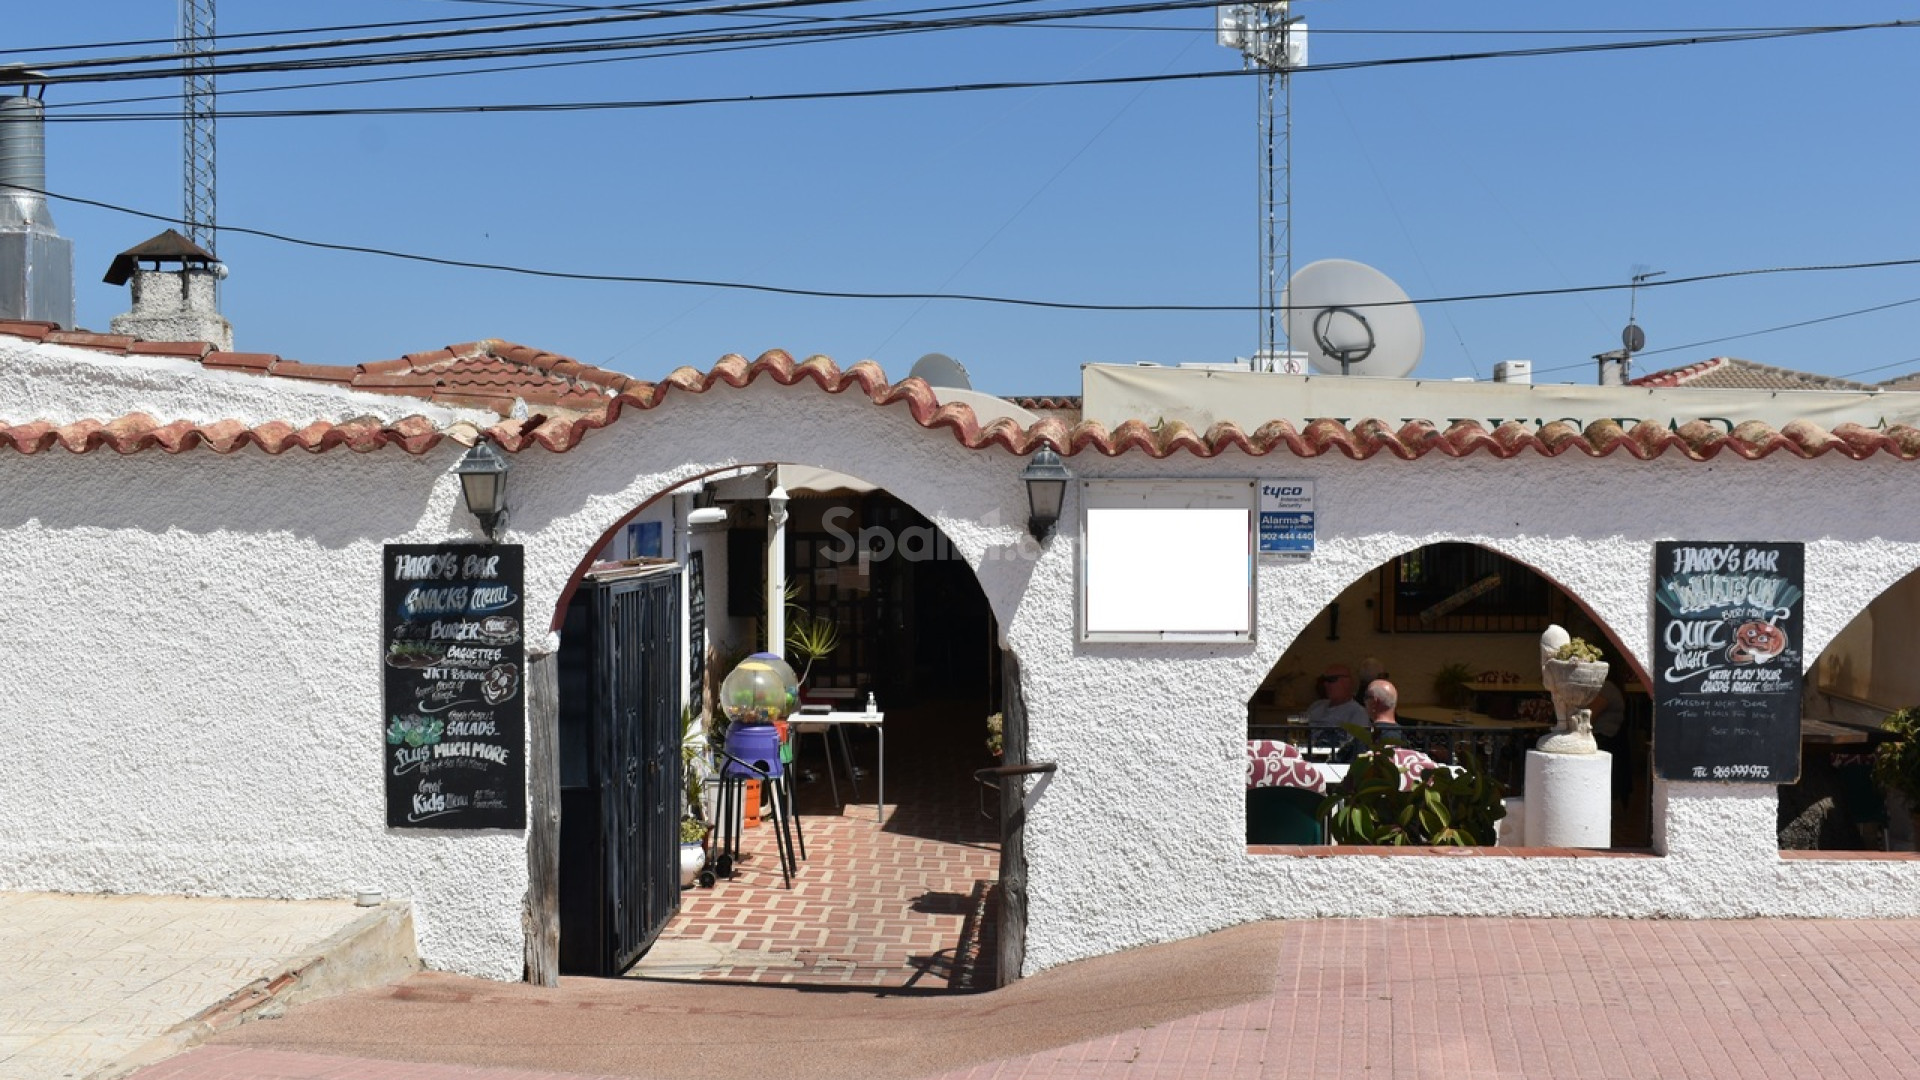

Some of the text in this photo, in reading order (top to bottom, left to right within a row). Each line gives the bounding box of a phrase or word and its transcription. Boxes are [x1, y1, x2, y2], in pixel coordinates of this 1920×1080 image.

[1262, 485, 1303, 498] tyco
[1262, 515, 1300, 524] Alarma
[1261, 532, 1313, 540] 902 444 440
[462, 554, 500, 579] BAR
[1672, 544, 1779, 574] HARRY'S BAR
[405, 586, 469, 615] SNACKS
[1748, 576, 1777, 610] ON
[431, 619, 480, 640] BURGER
[1664, 620, 1726, 652] QUIZ
[1674, 650, 1714, 671] NIGHT
[422, 668, 449, 680] JKT
[1708, 668, 1783, 681] WITH PLAY YOUR
[1701, 680, 1731, 693] CARDS
[1731, 682, 1761, 693] RIGHT
[395, 745, 430, 767] PLUS
[434, 741, 472, 758] MUCH
[472, 742, 510, 765] MORE
[1691, 765, 1709, 778] TEL
[412, 793, 445, 815] Kids
